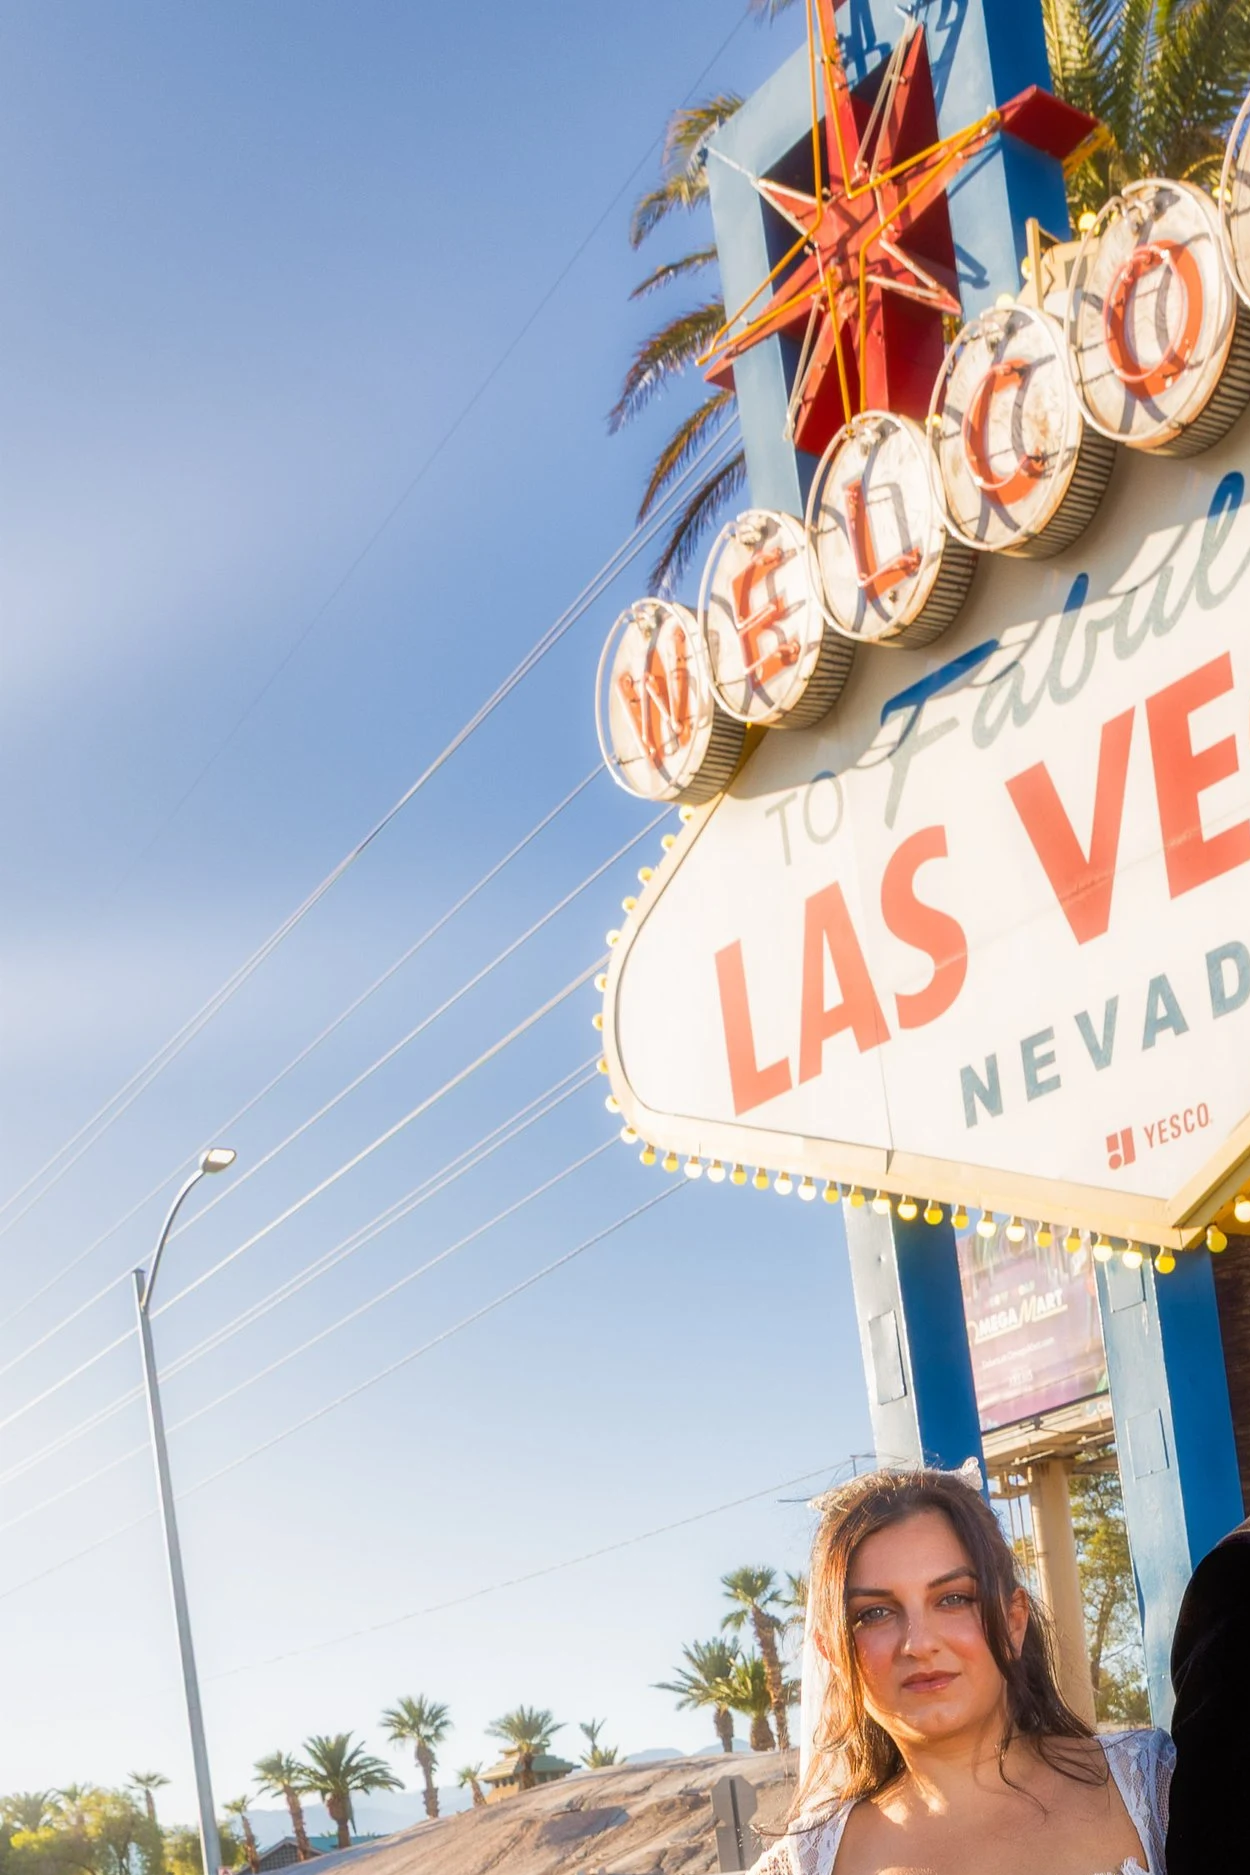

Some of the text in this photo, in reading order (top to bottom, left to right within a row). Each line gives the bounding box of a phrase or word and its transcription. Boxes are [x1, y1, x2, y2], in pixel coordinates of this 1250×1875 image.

[764, 770, 844, 867] TO
[714, 824, 969, 1116] LAS
[1143, 1102, 1209, 1149] YESCO
[1017, 1287, 1066, 1323] MART
